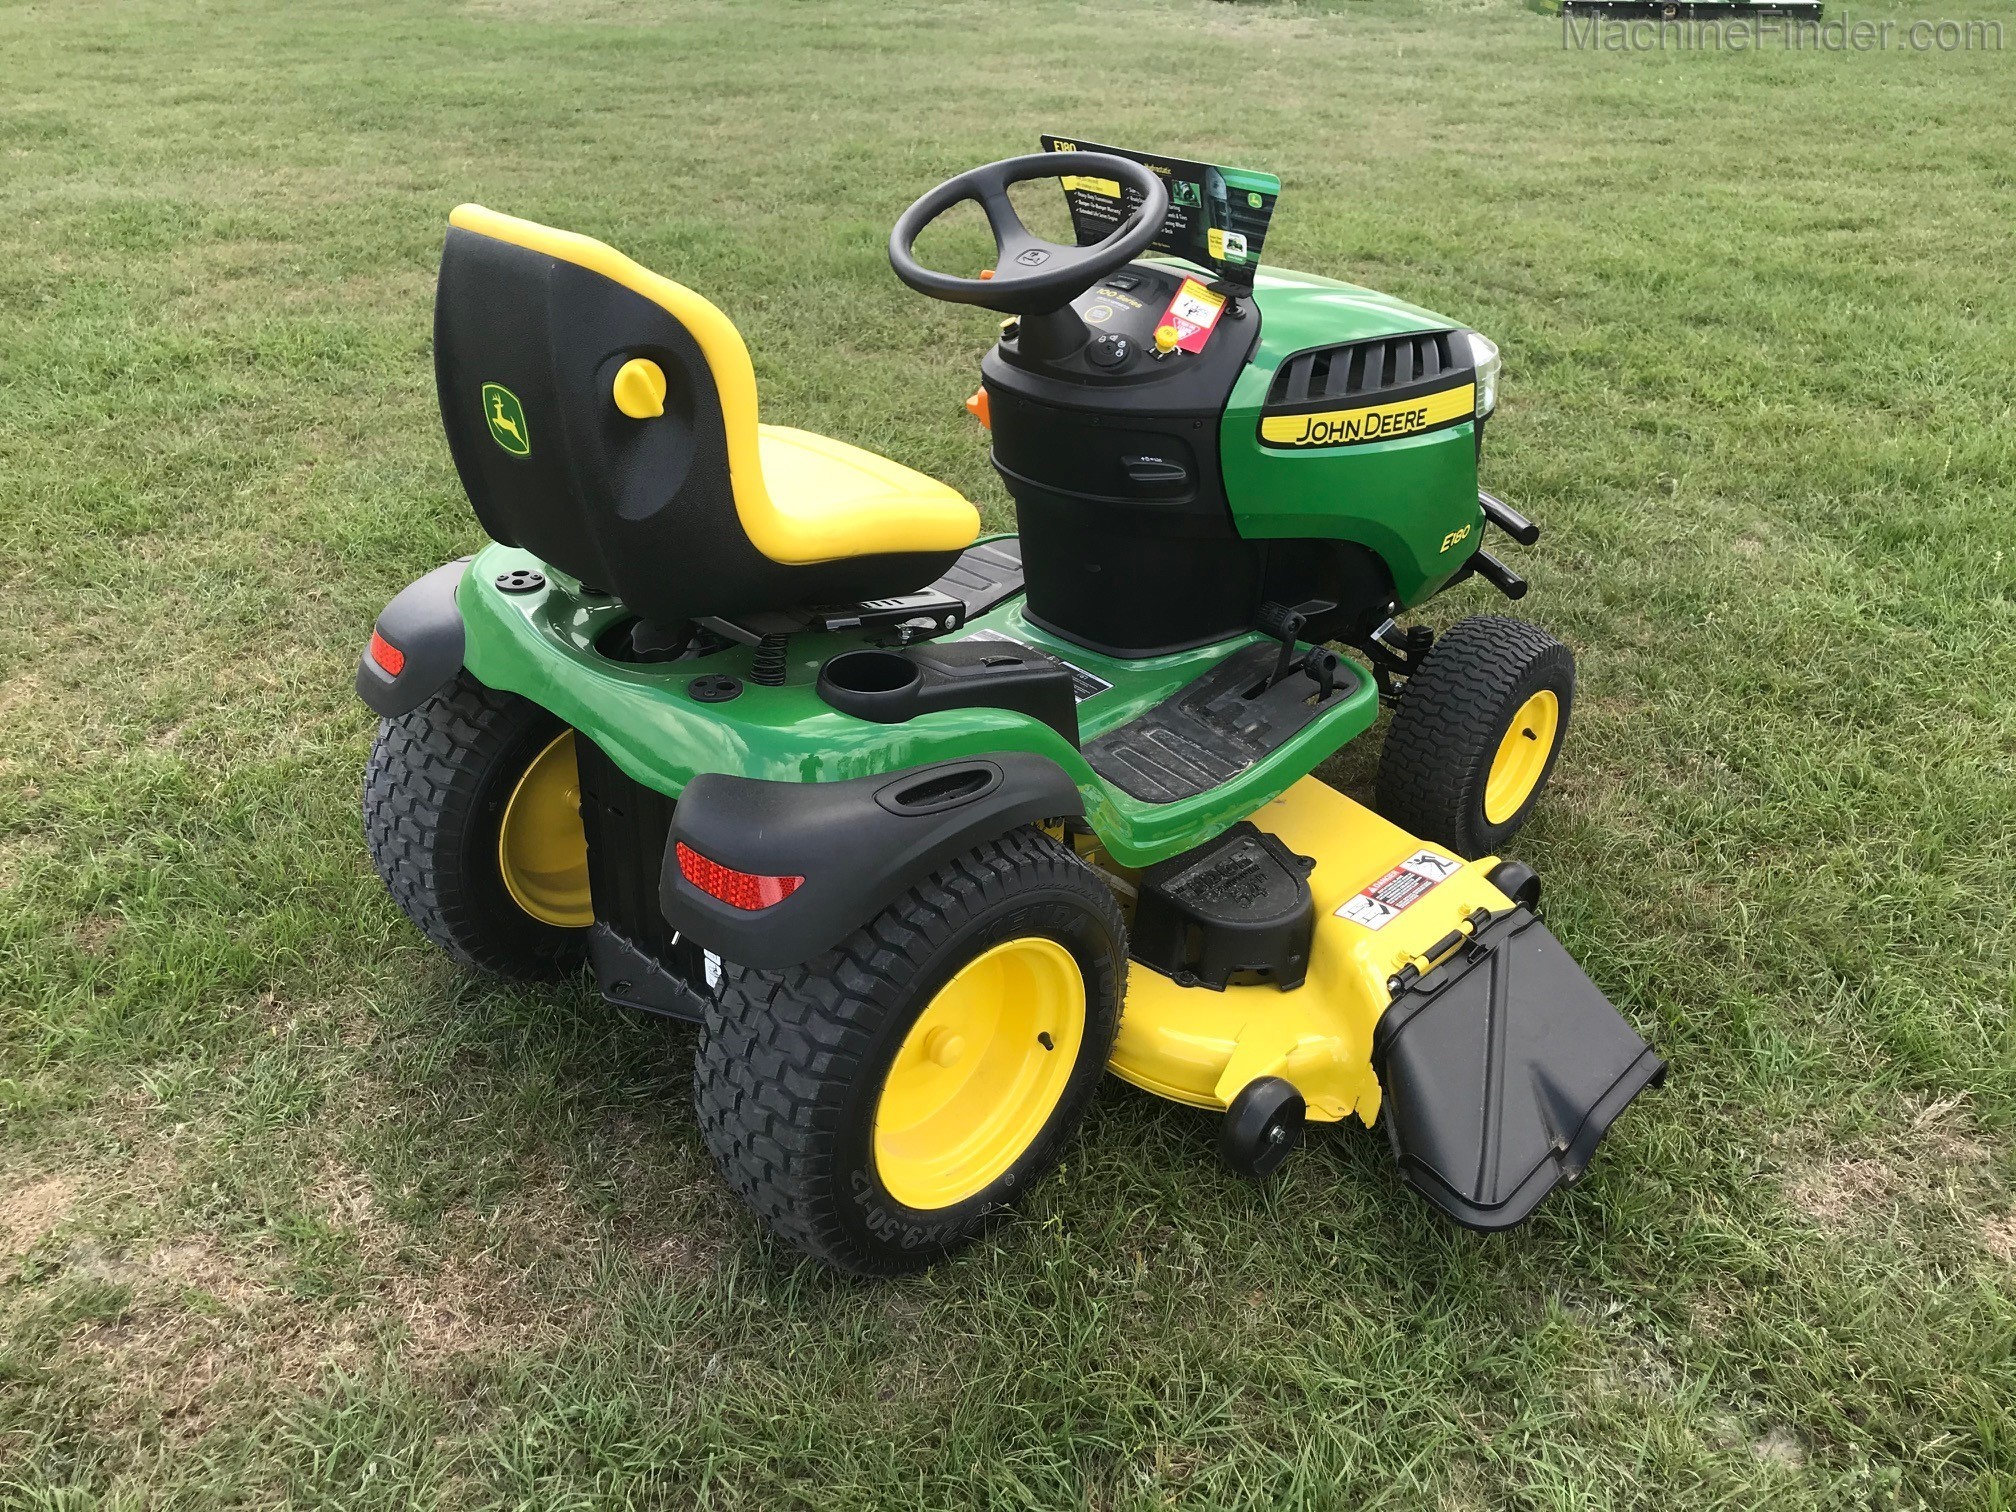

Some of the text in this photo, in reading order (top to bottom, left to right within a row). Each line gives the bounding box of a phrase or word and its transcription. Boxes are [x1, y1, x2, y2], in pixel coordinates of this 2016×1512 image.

[1296, 407, 1428, 443] JOHN DEERE
[1439, 524, 1471, 554] E180
[1373, 869, 1400, 891] DANGER
